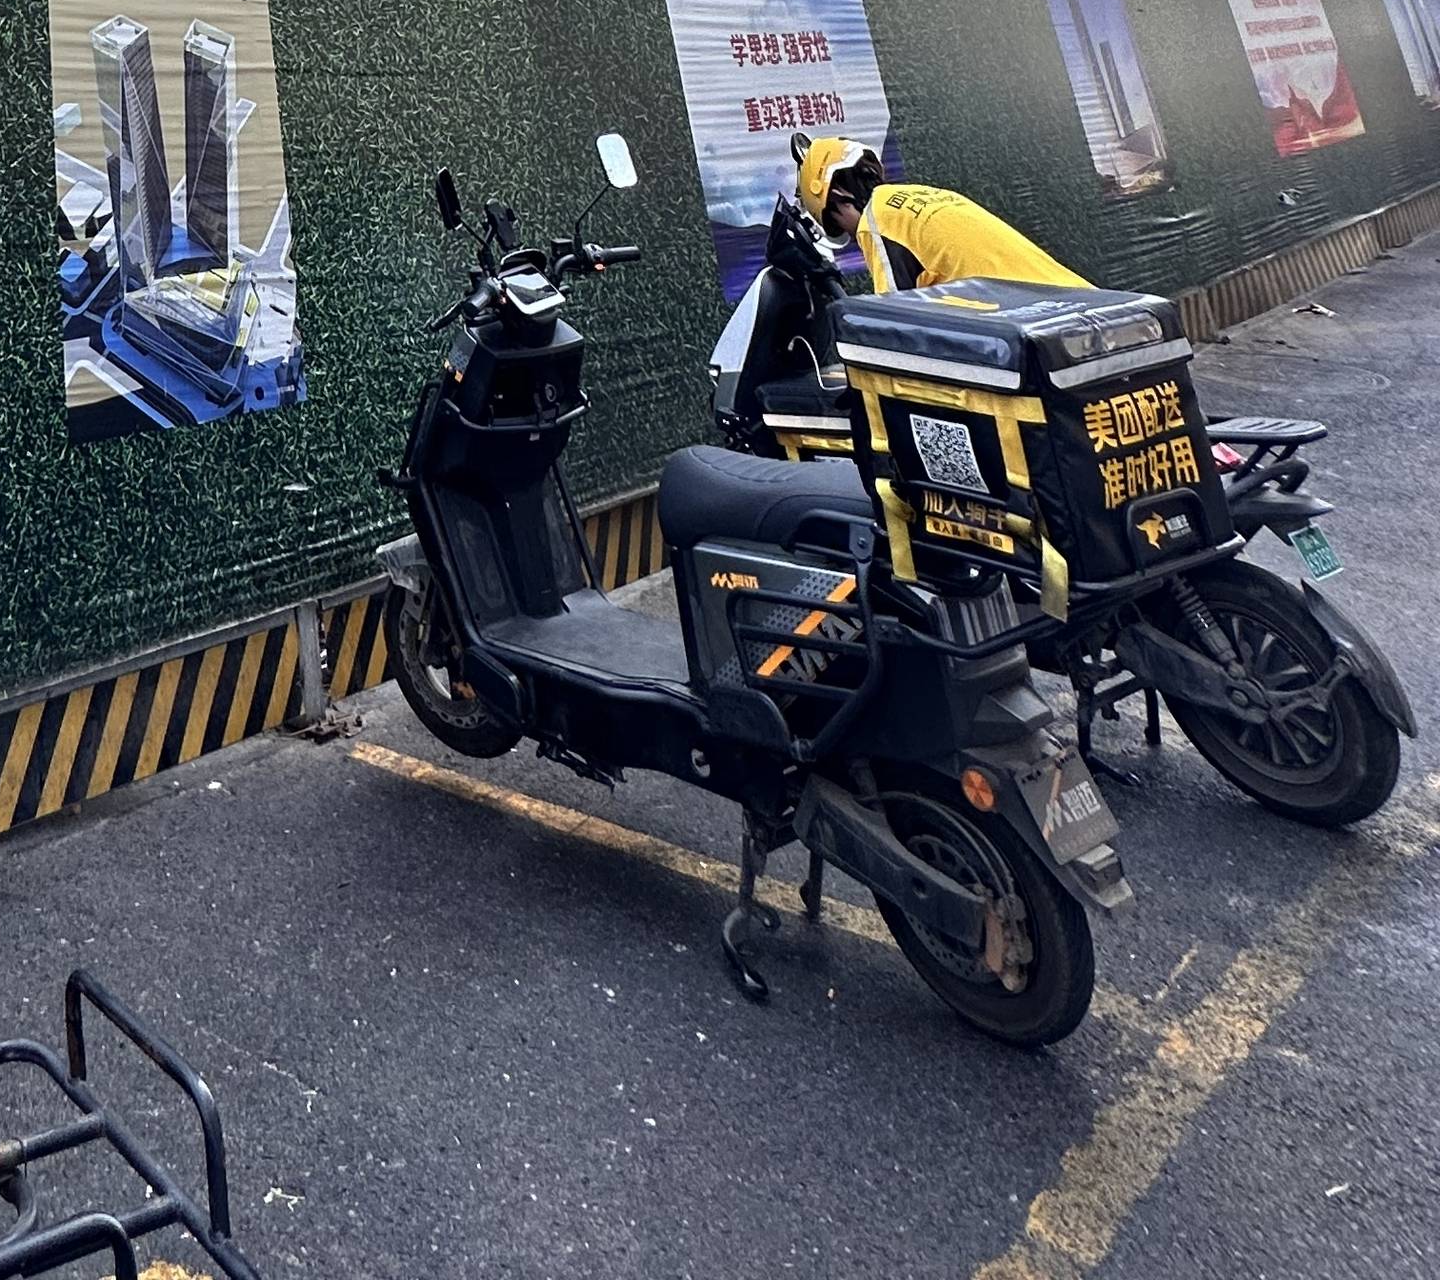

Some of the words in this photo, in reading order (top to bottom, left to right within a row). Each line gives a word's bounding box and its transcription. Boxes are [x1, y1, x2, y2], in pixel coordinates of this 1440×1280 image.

[729, 31, 782, 67] 学思想
[781, 30, 832, 65] 强党性
[743, 94, 797, 132] 重实践
[795, 91, 845, 127] 建新功
[1083, 380, 1186, 453] 美团配送
[1098, 435, 1201, 510] 准时好用
